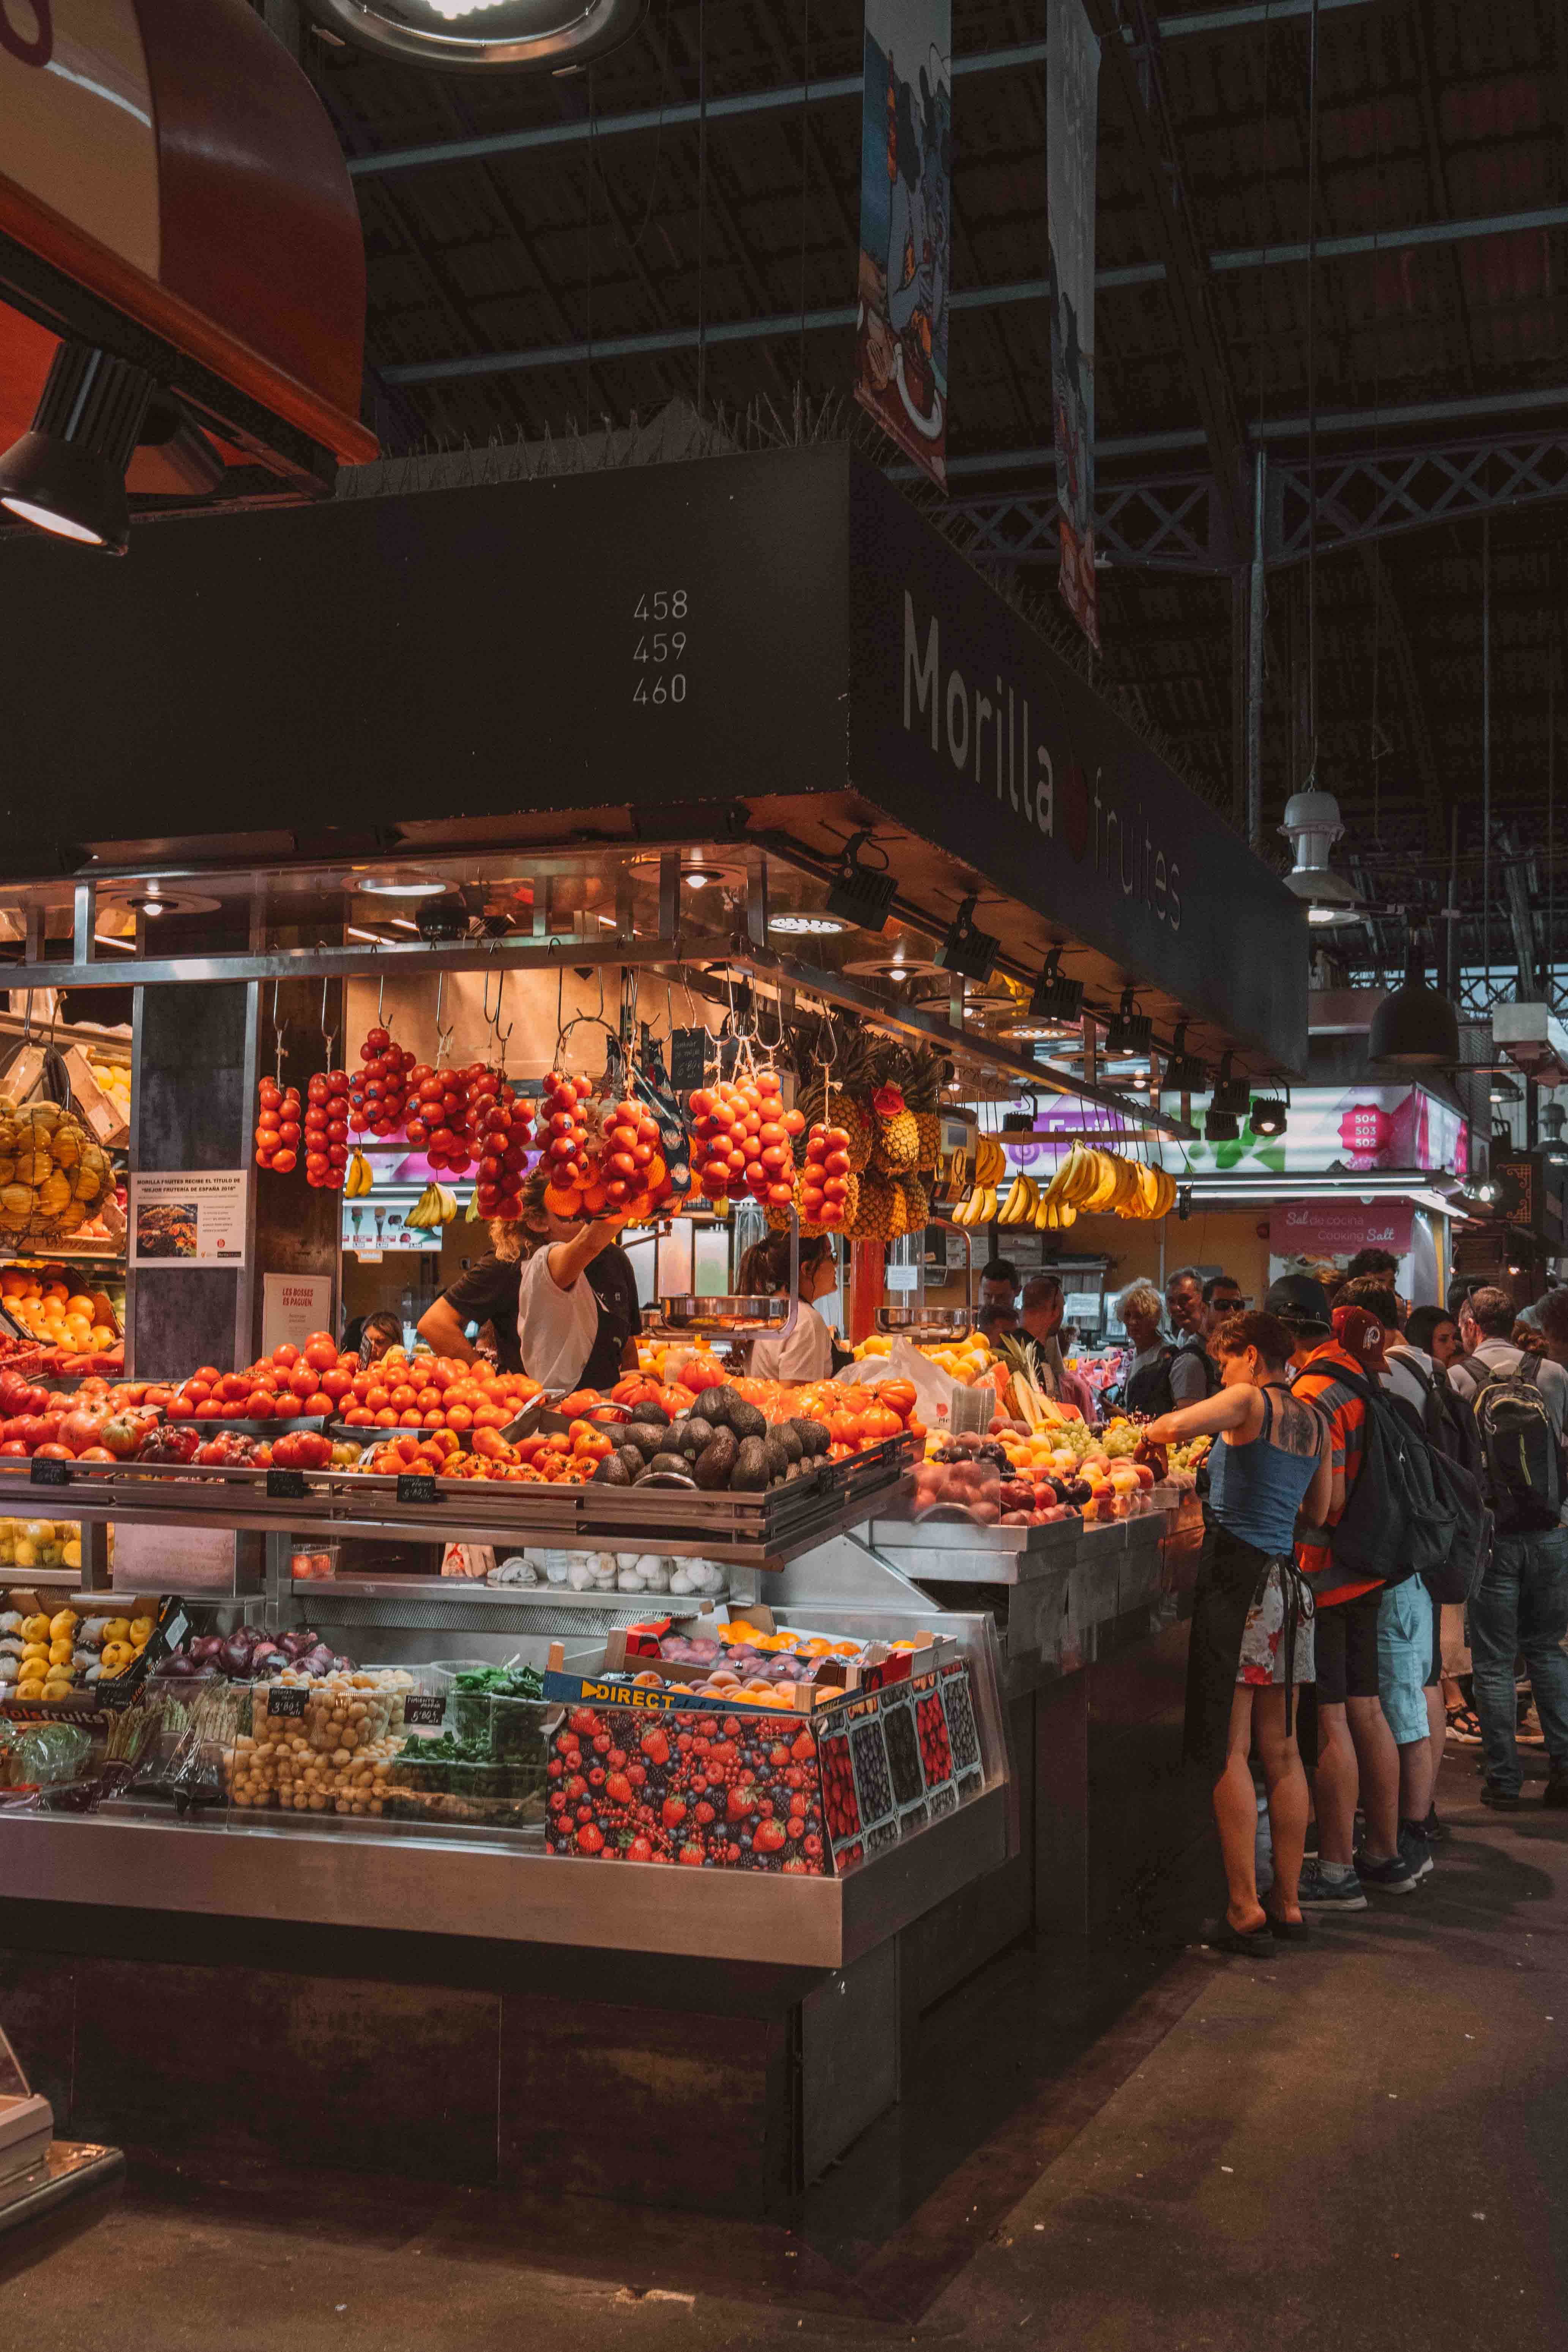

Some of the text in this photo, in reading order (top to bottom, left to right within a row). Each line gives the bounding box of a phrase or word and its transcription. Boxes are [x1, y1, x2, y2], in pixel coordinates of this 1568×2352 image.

[634, 589, 688, 621] 458
[633, 631, 687, 663] 459
[633, 674, 687, 705] 460
[904, 590, 1053, 838] Morilla
[1093, 766, 1182, 932] fruites
[1355, 1114, 1376, 1123] 504
[1355, 1126, 1376, 1136] 503
[1355, 1138, 1376, 1147] 502
[1286, 1210, 1364, 1226] Sal de cocina
[1318, 1228, 1394, 1242] Cooking Salt
[293, 1288, 313, 1297] BOSSES
[282, 1297, 289, 1305] ES
[596, 1683, 675, 1710] DIRECT
